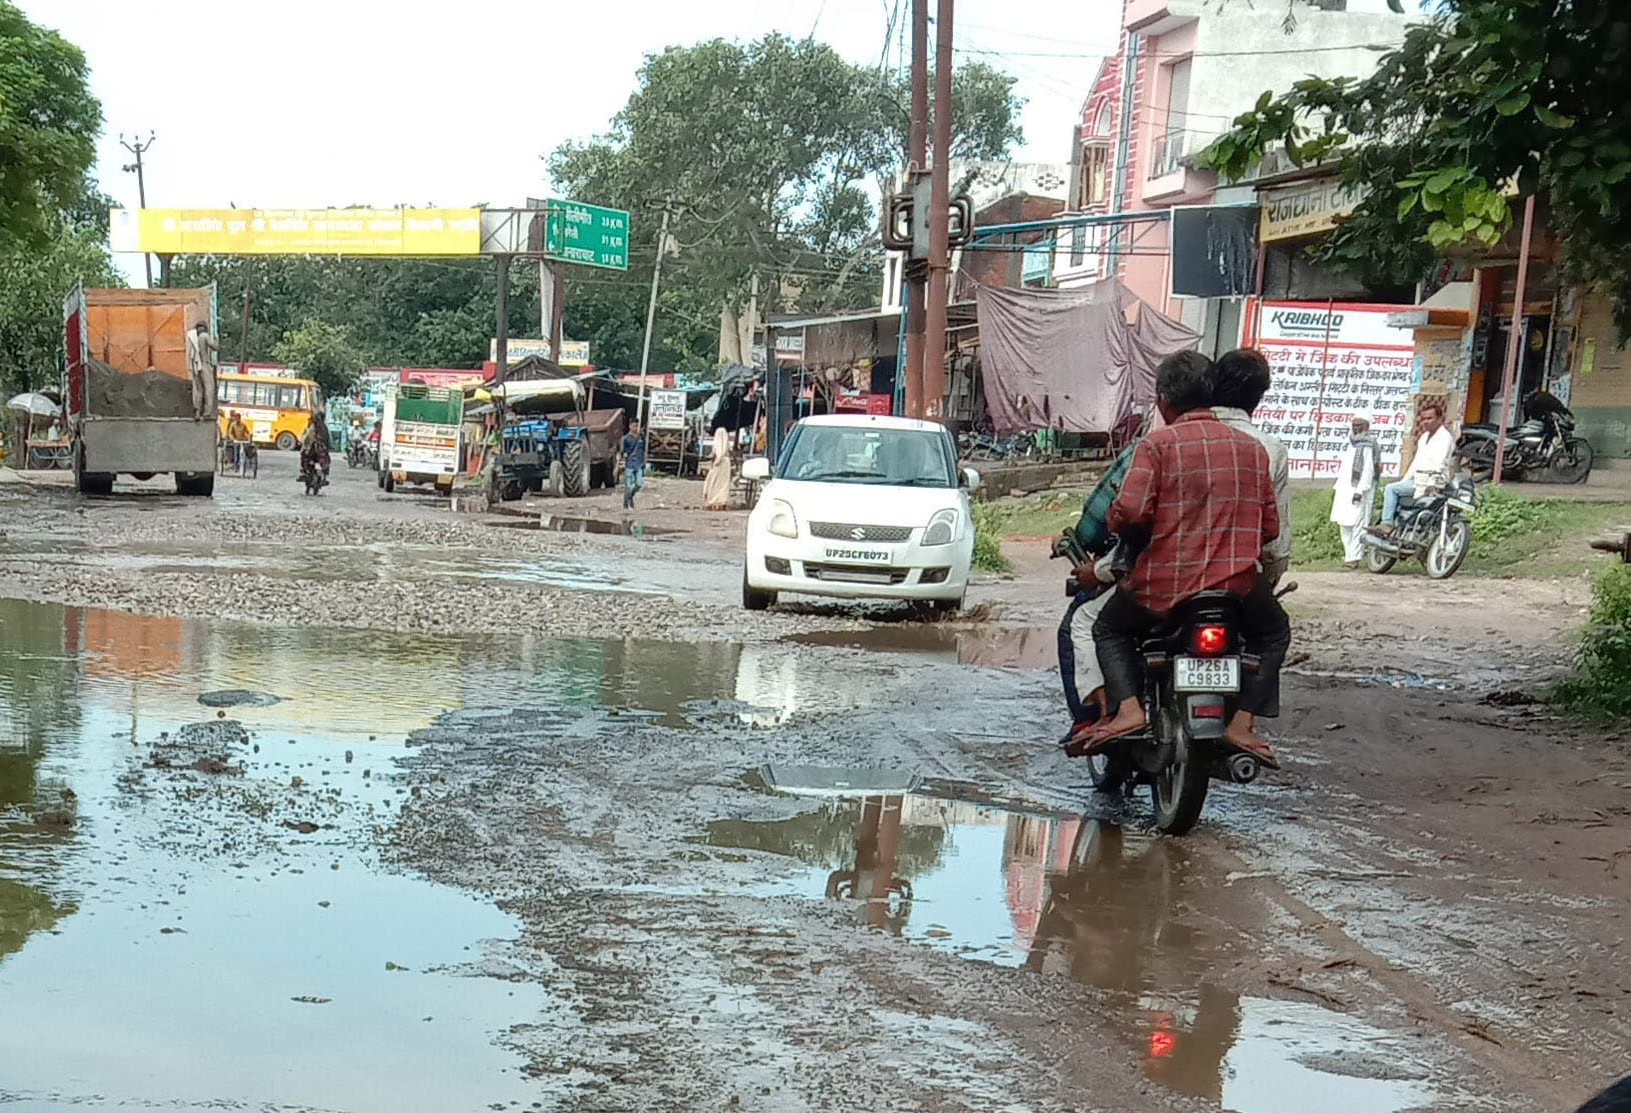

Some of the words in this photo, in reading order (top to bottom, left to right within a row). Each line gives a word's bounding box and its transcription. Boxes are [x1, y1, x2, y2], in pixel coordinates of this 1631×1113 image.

[1271, 311, 1345, 328] KRIBHCO
[1289, 411, 1307, 422] पर
[1187, 659, 1230, 673] UP26A
[1187, 673, 1230, 685] C9833
